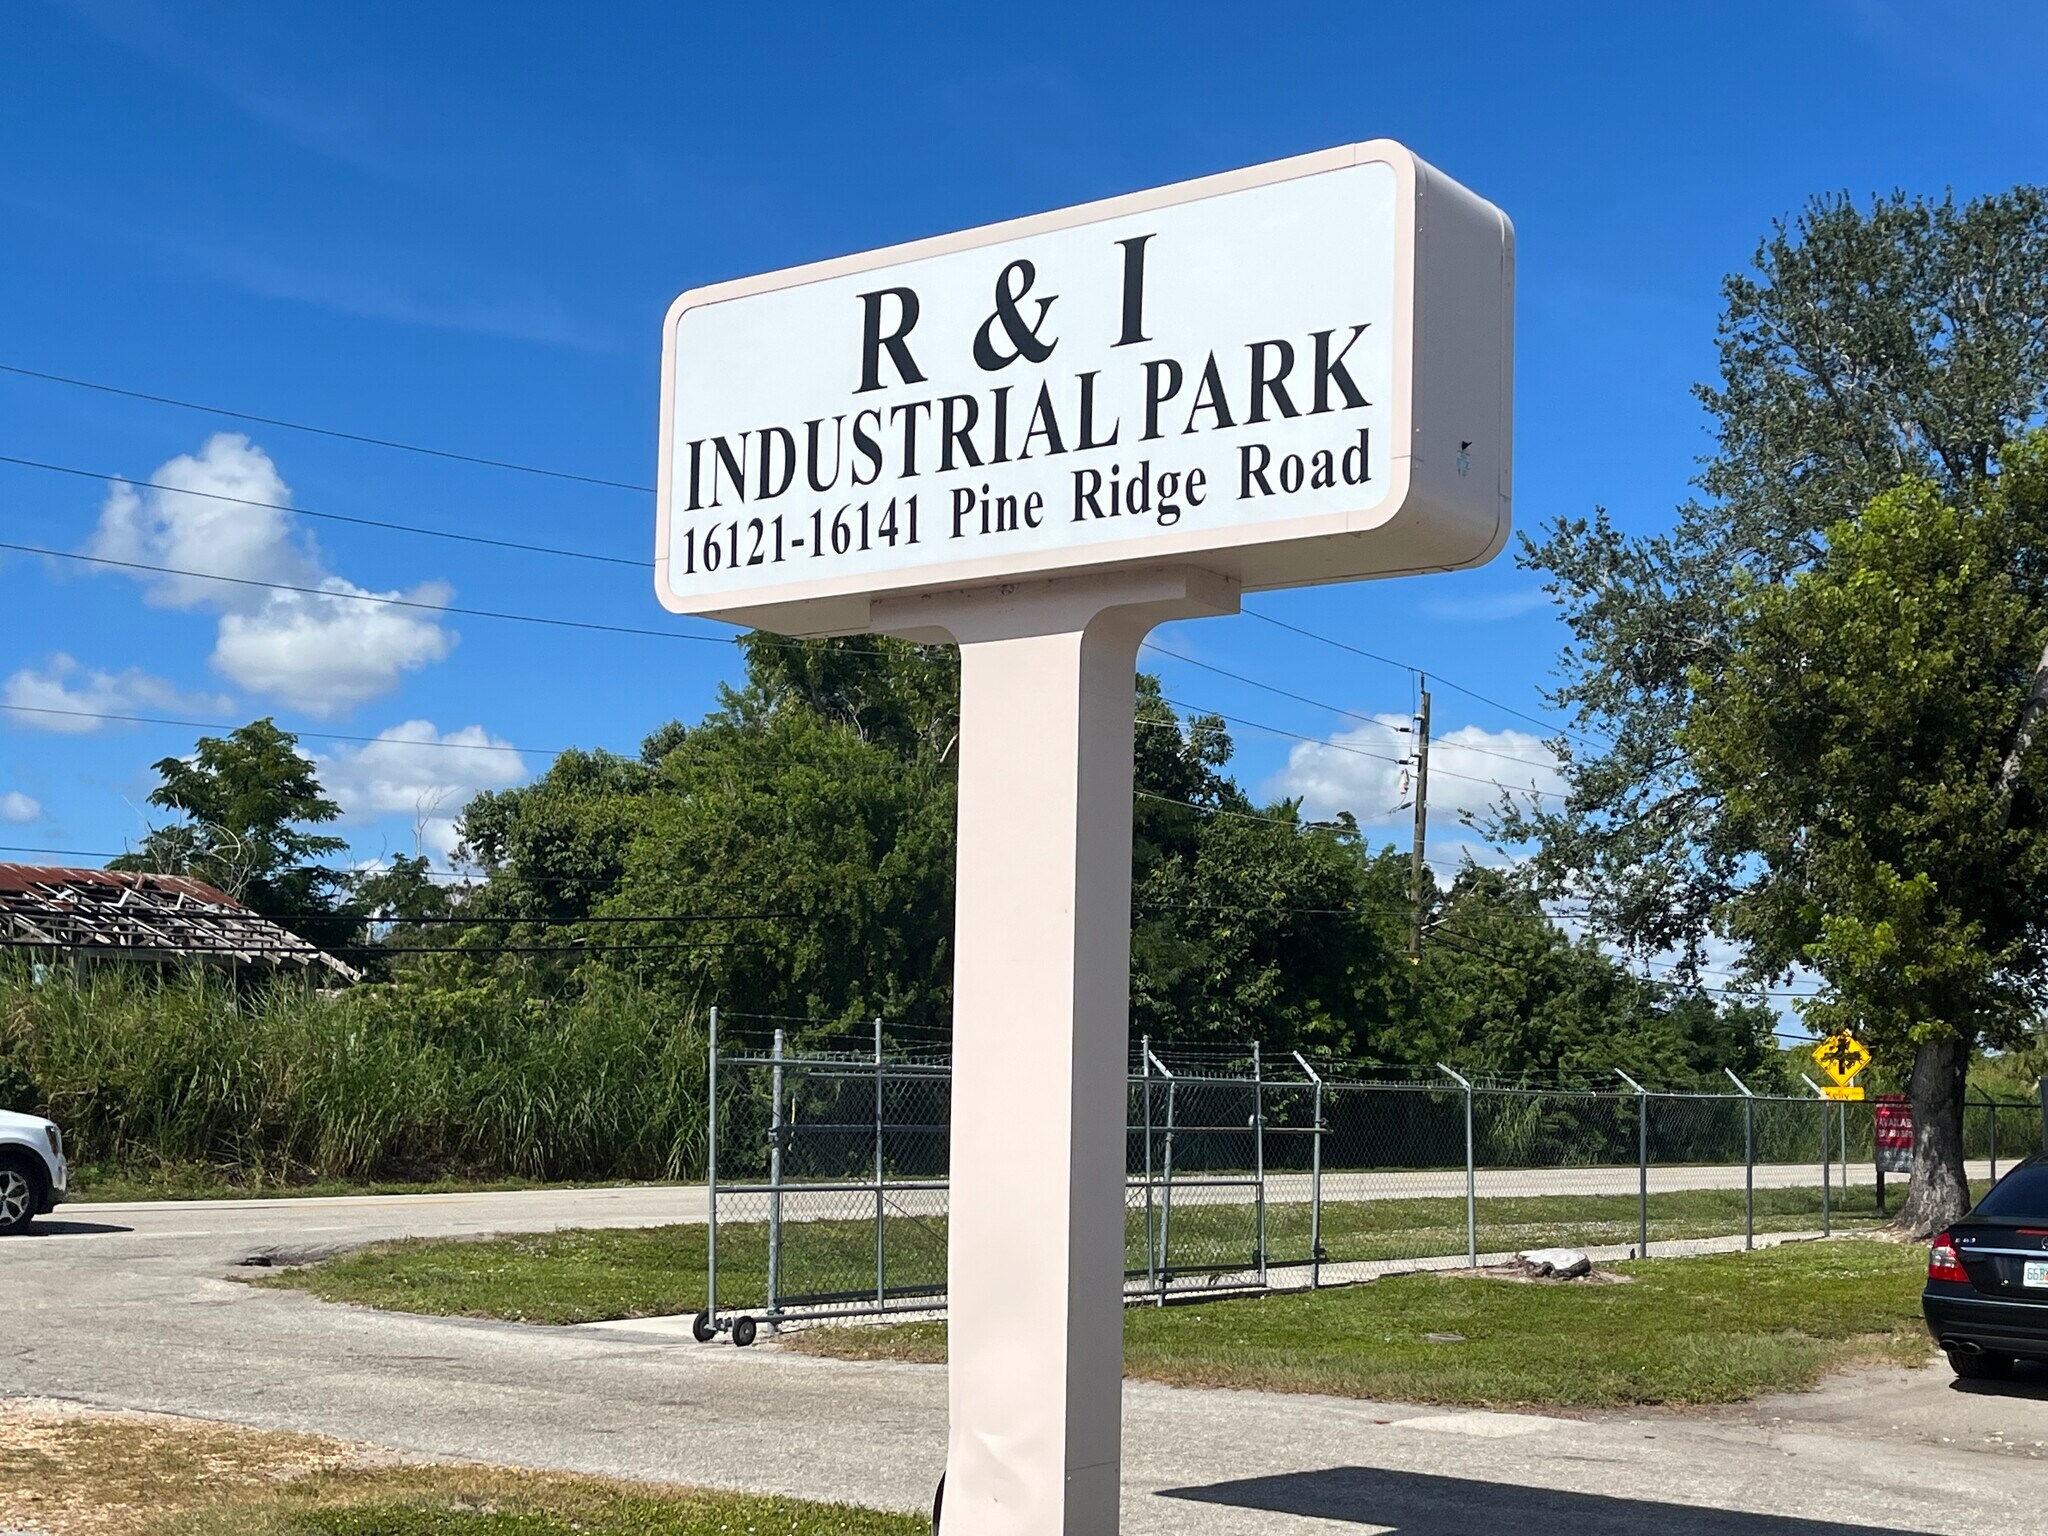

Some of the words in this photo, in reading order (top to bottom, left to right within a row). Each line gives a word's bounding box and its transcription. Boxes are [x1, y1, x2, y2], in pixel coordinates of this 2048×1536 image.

[851, 286, 929, 395] R
[972, 259, 1060, 372] &
[1110, 232, 1157, 348] I
[684, 370, 1120, 512] INDUSTRIAL
[1138, 323, 1373, 442] PARK
[684, 494, 920, 575] 16121-16141
[949, 483, 1044, 539] Pine
[1070, 460, 1207, 527] Ridge
[1237, 427, 1372, 500] Road
[1879, 1118, 1913, 1128] AVAILAB
